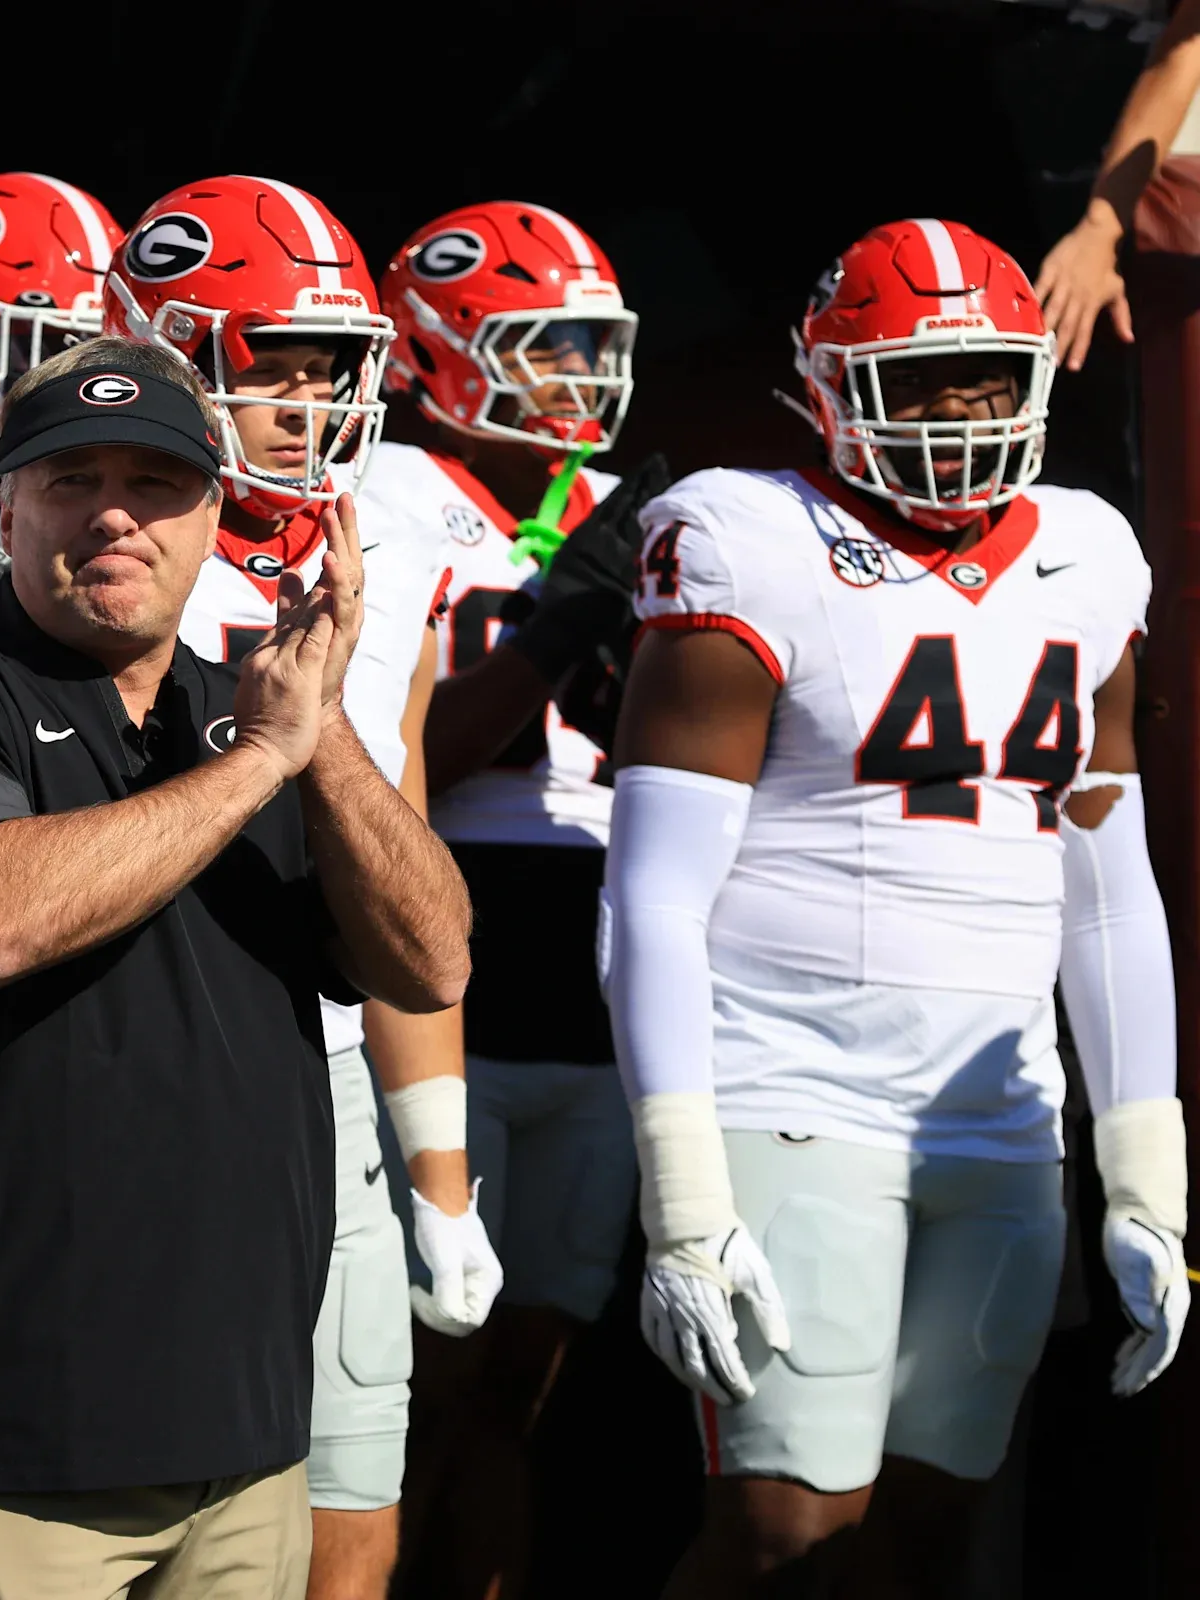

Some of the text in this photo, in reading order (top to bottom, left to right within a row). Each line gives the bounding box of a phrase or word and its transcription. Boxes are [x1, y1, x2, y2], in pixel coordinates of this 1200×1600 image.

[125, 215, 209, 278] G
[413, 233, 481, 278] G
[311, 293, 363, 308] DAWGS
[926, 318, 984, 330] DAWGS
[81, 376, 138, 404] G
[247, 555, 283, 578] G
[950, 563, 985, 588] G
[855, 634, 1084, 835] 44
